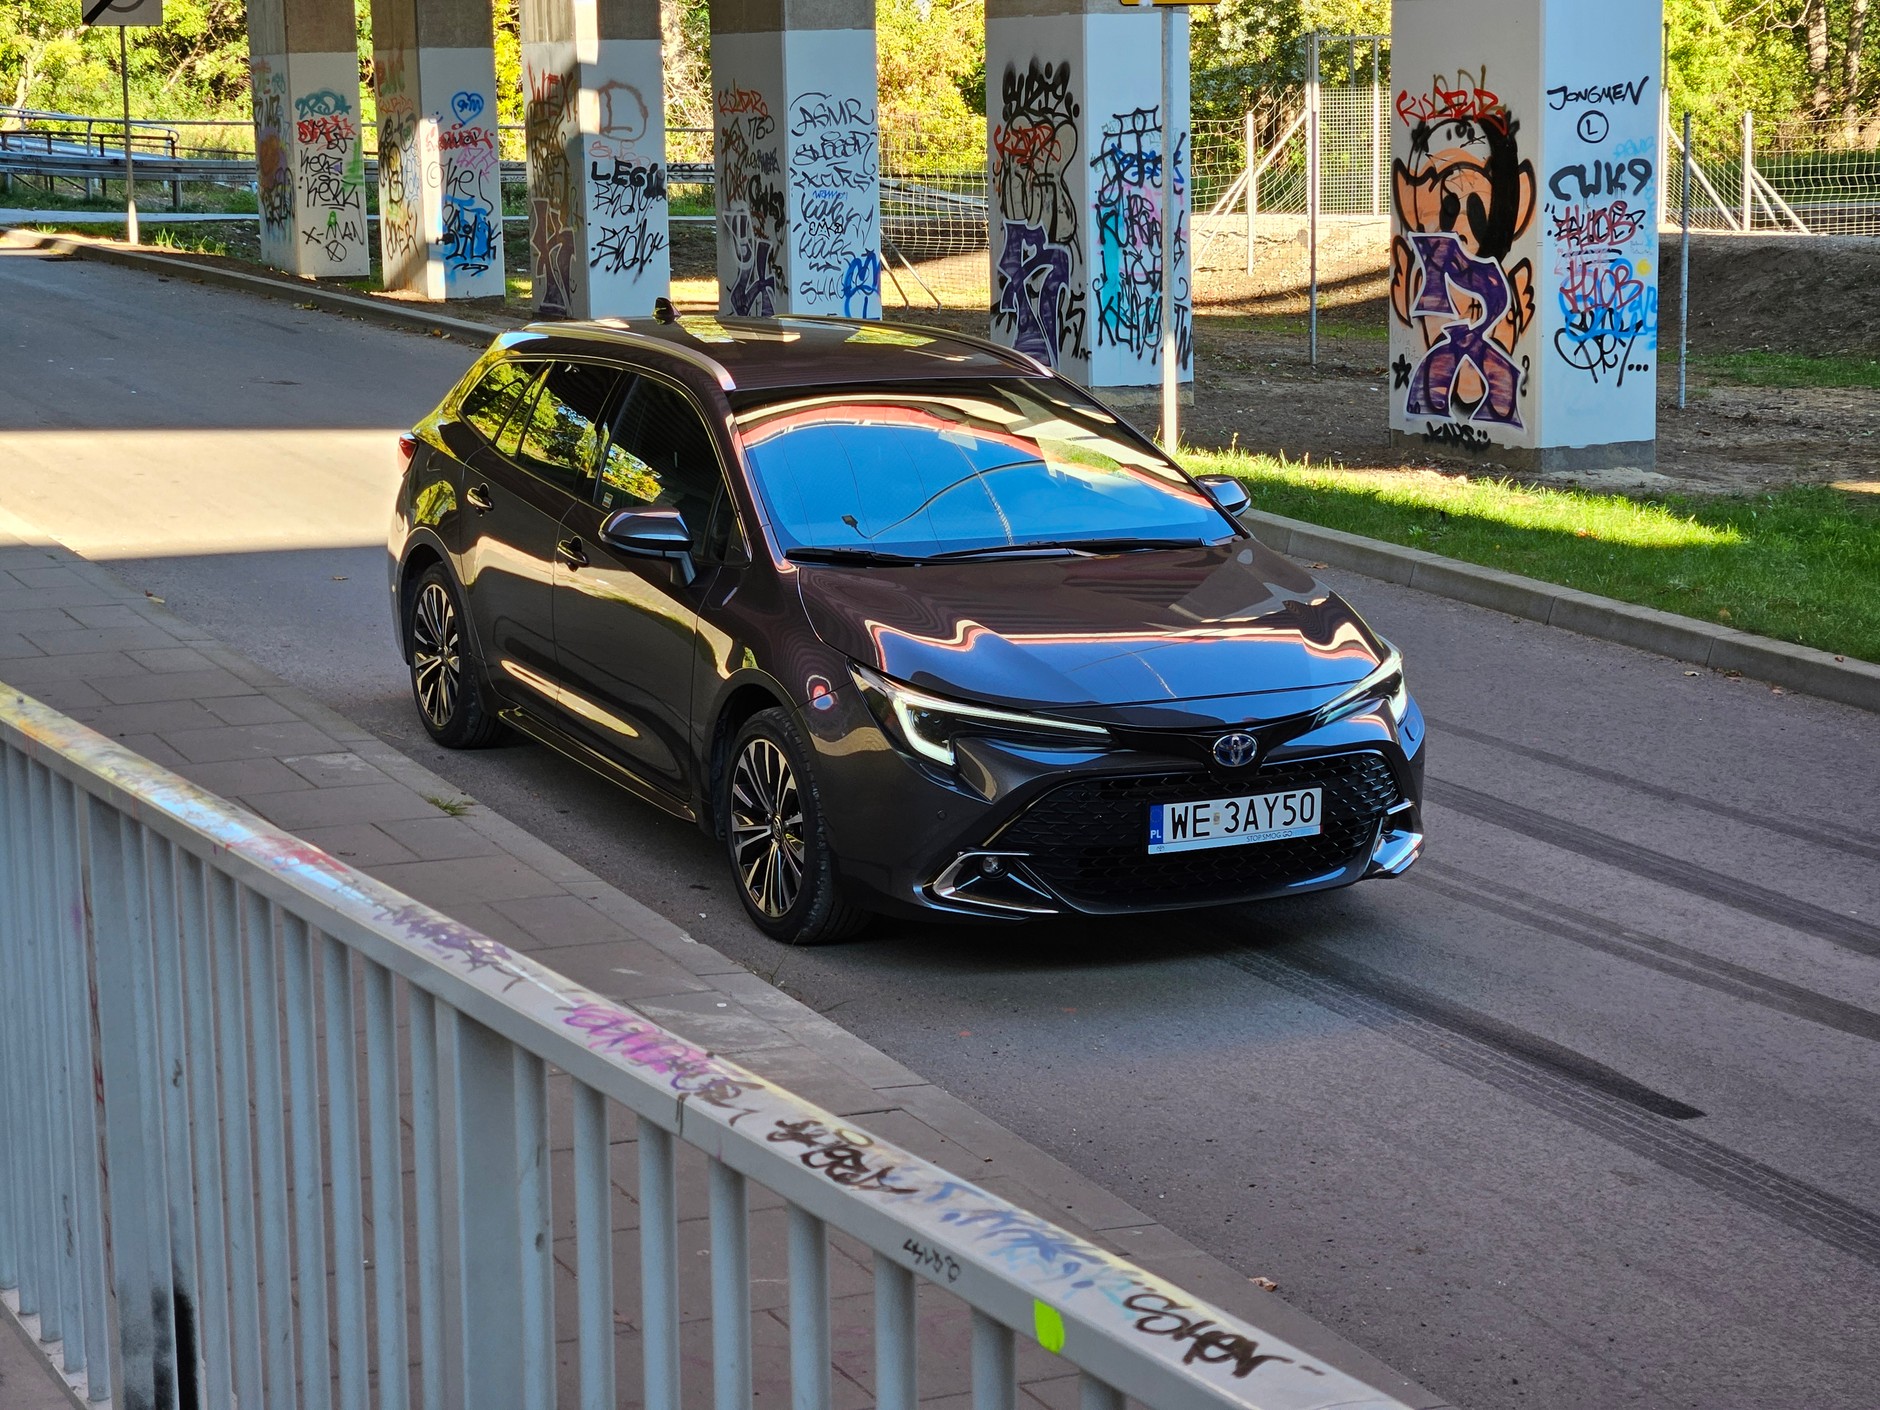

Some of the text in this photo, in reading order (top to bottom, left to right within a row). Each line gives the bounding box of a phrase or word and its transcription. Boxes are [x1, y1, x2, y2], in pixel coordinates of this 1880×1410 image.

[1546, 75, 1650, 110] JONGMEN
[1171, 791, 1315, 839] WE 3AY50
[1150, 829, 1162, 839] PL
[1262, 832, 1282, 841] SMOG
